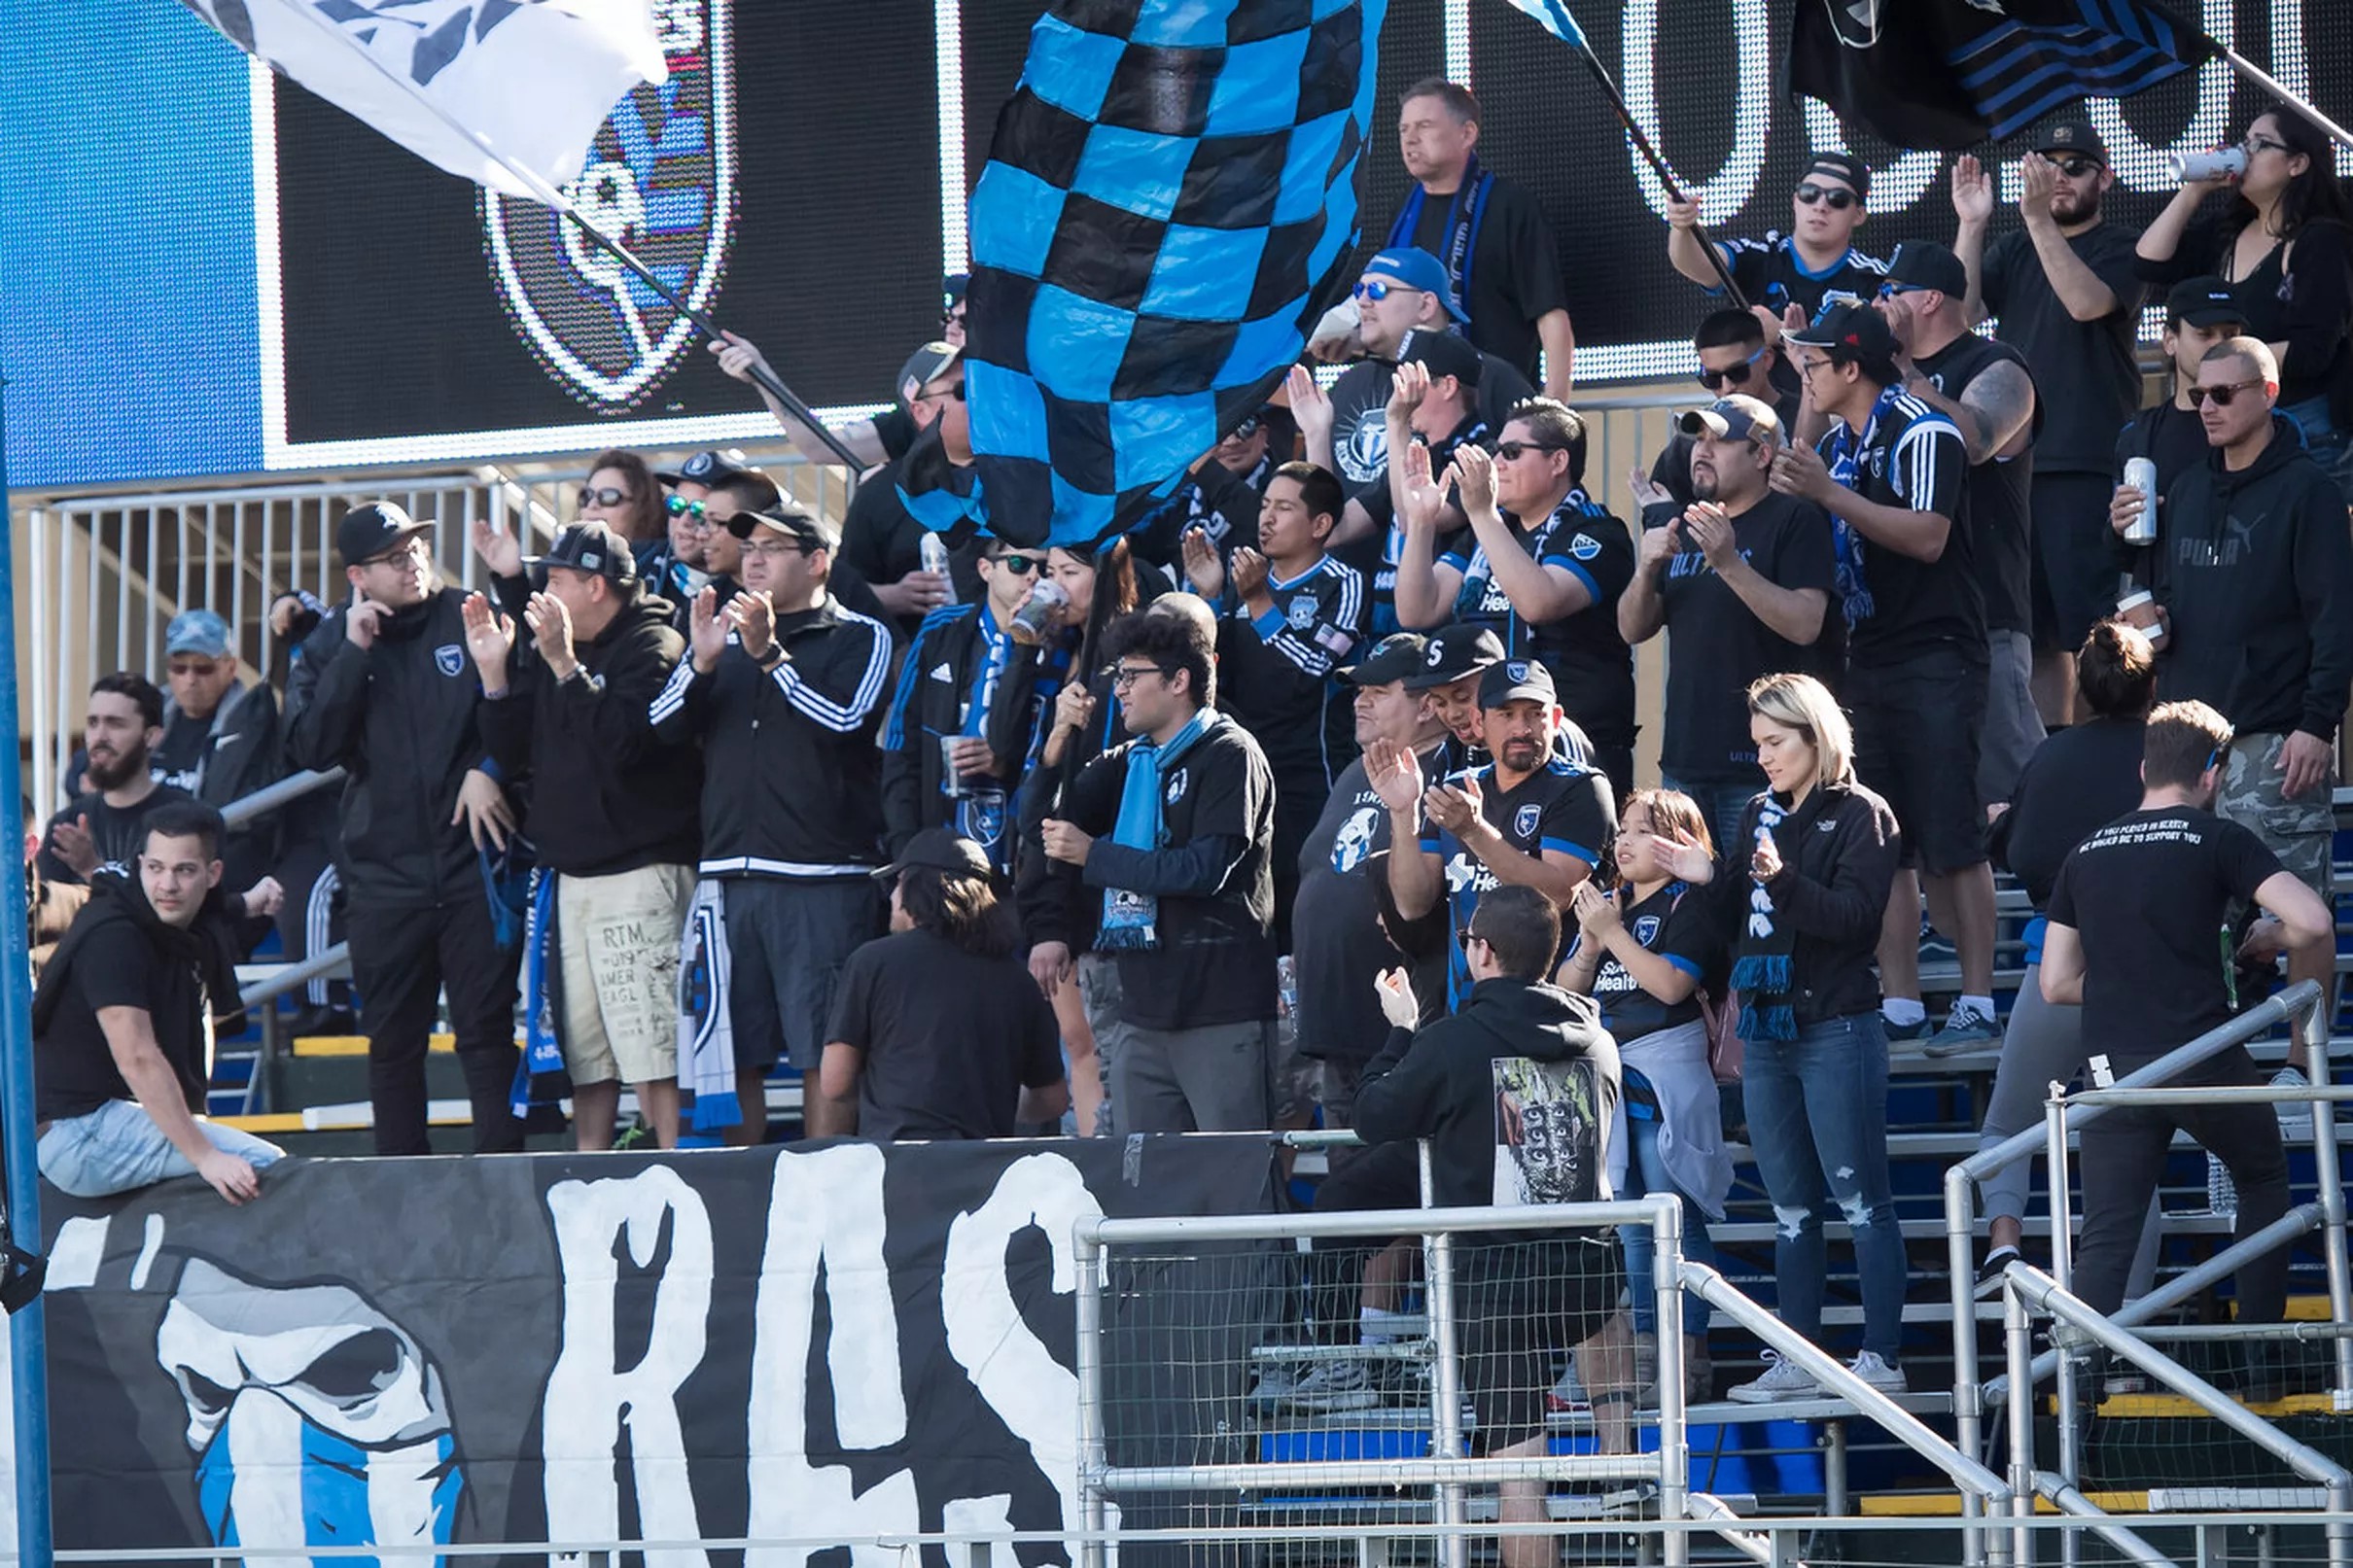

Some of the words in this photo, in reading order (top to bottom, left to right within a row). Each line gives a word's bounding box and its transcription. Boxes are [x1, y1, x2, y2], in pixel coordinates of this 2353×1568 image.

[1427, 640, 1444, 667] S
[1352, 790, 1388, 809] 190
[2183, 832, 2202, 845] YOU
[1593, 973, 1643, 992] Healt
